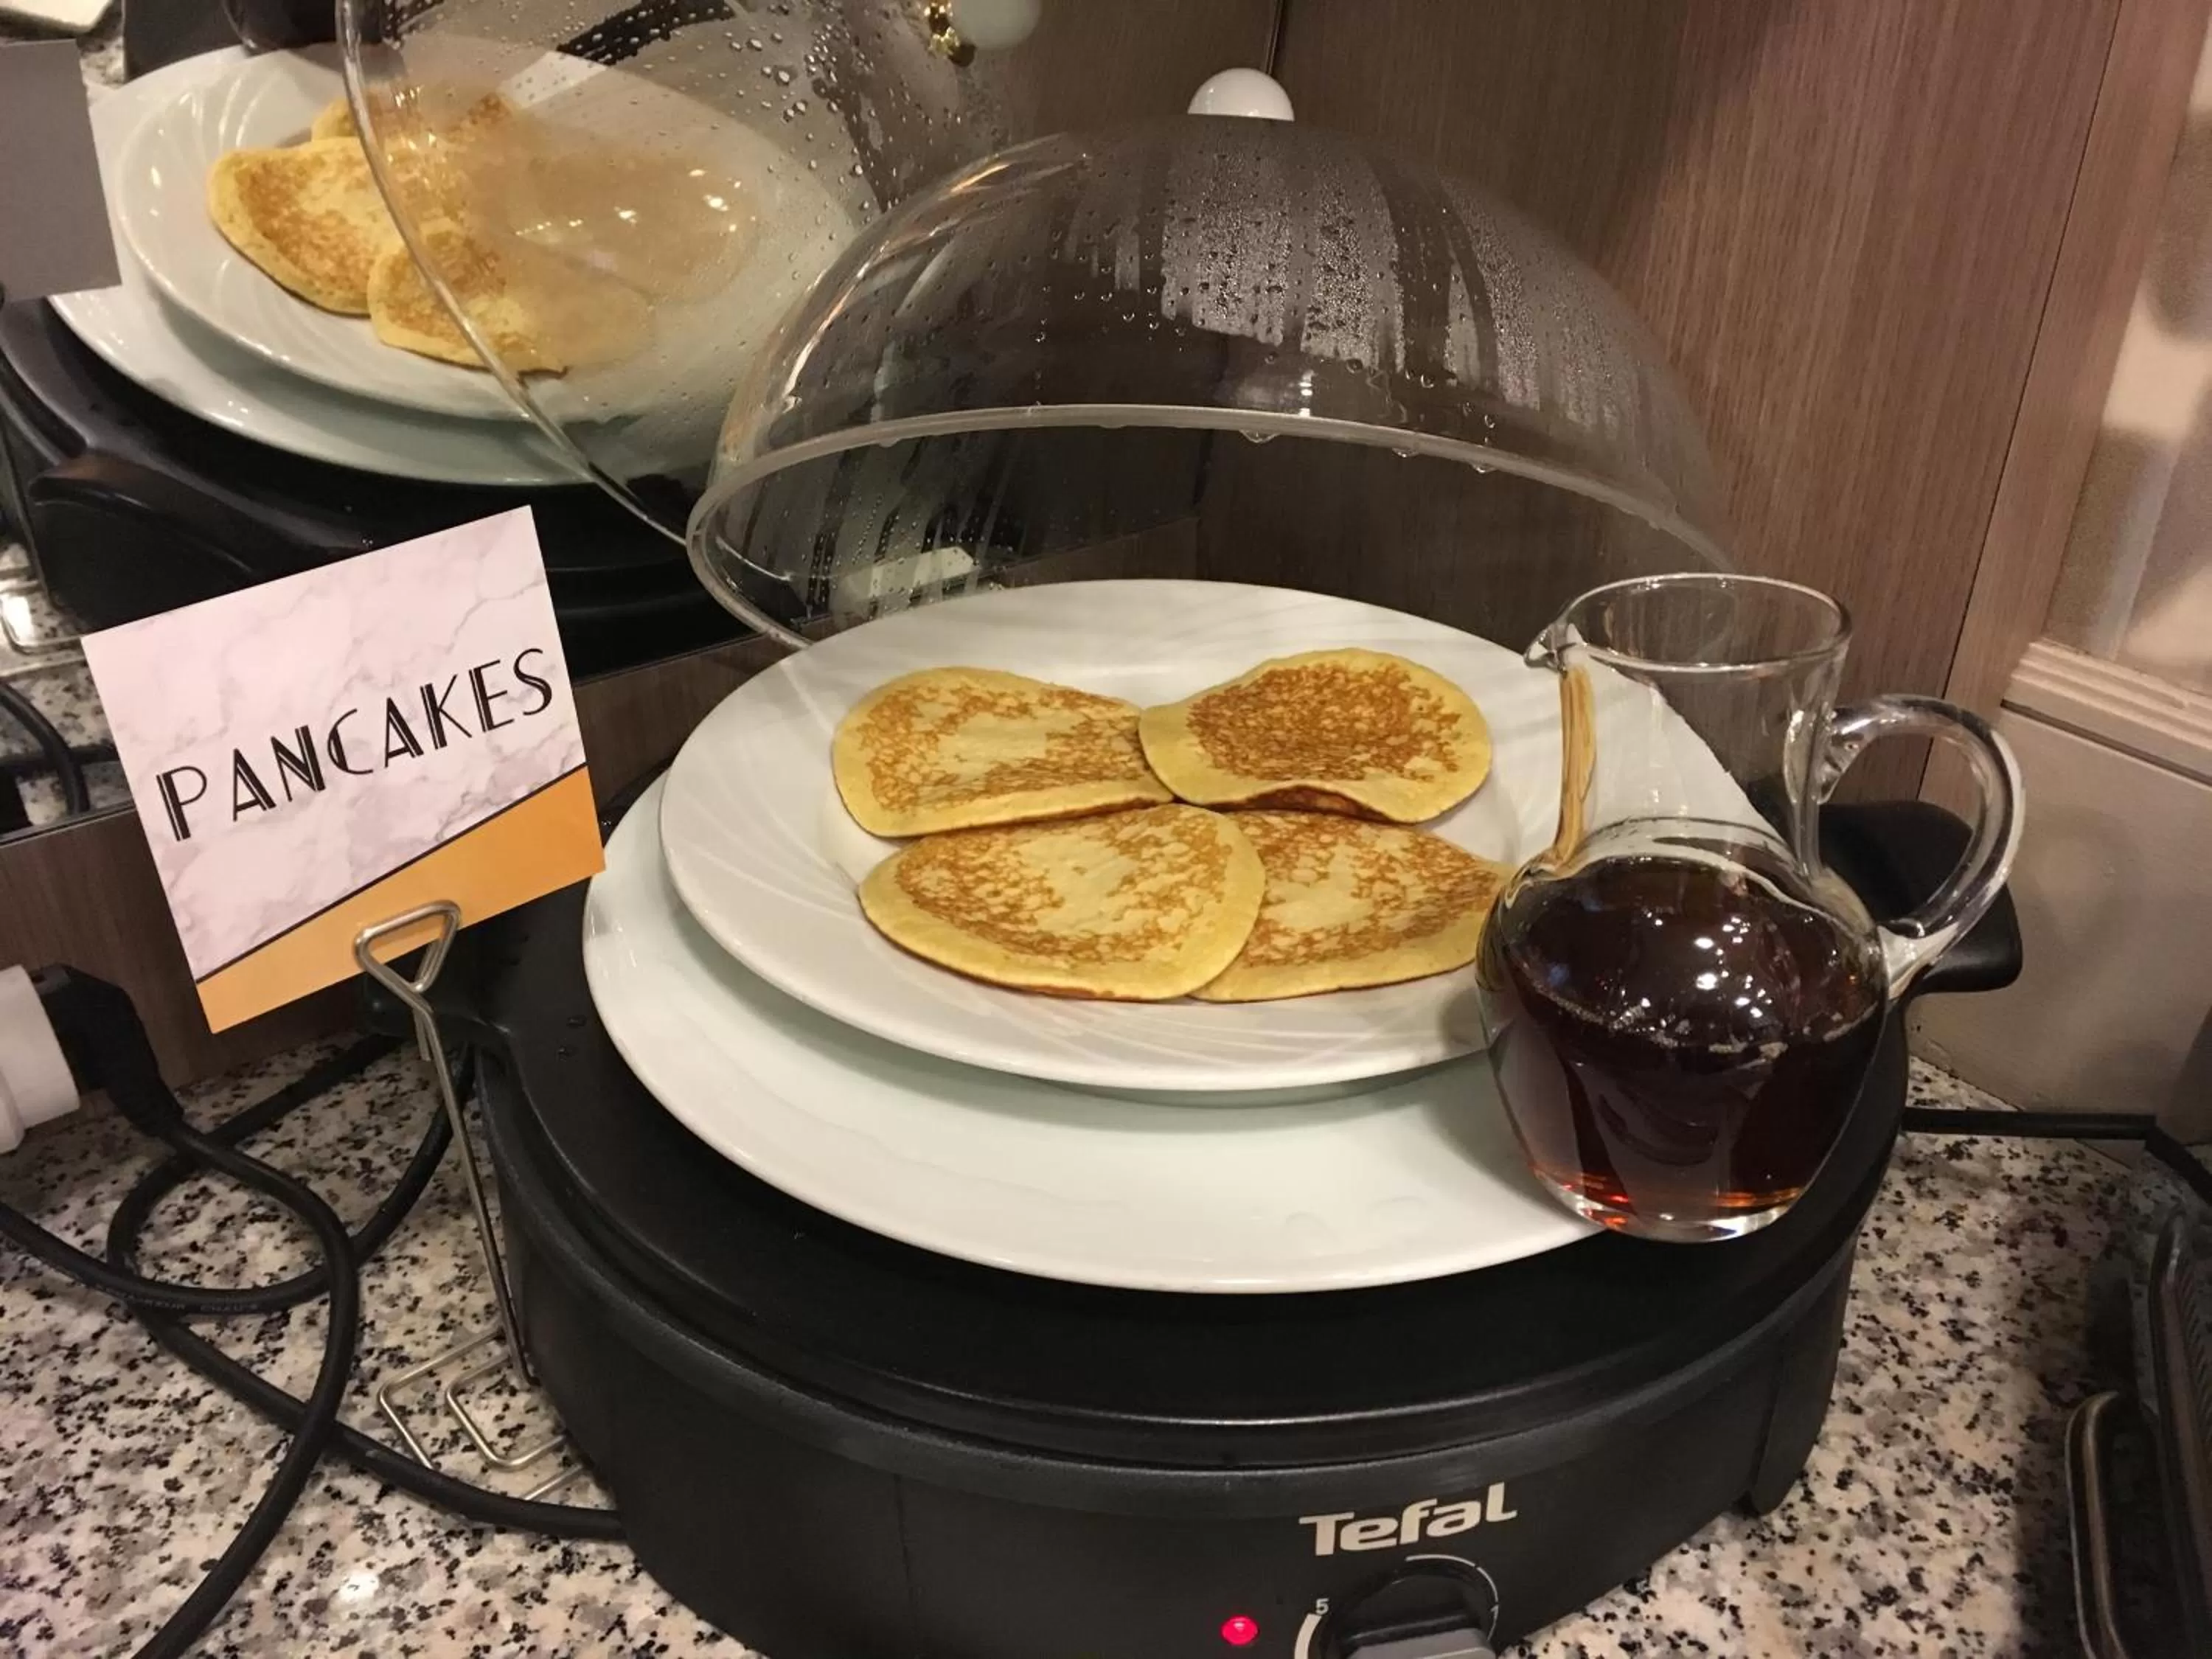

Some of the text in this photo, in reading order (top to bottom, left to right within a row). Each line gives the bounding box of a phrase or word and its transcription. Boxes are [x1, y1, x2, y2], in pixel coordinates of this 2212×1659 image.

[156, 648, 552, 841] PANCAKES
[1298, 1482, 1517, 1556] Tefal
[1315, 1598, 1329, 1615] 5
